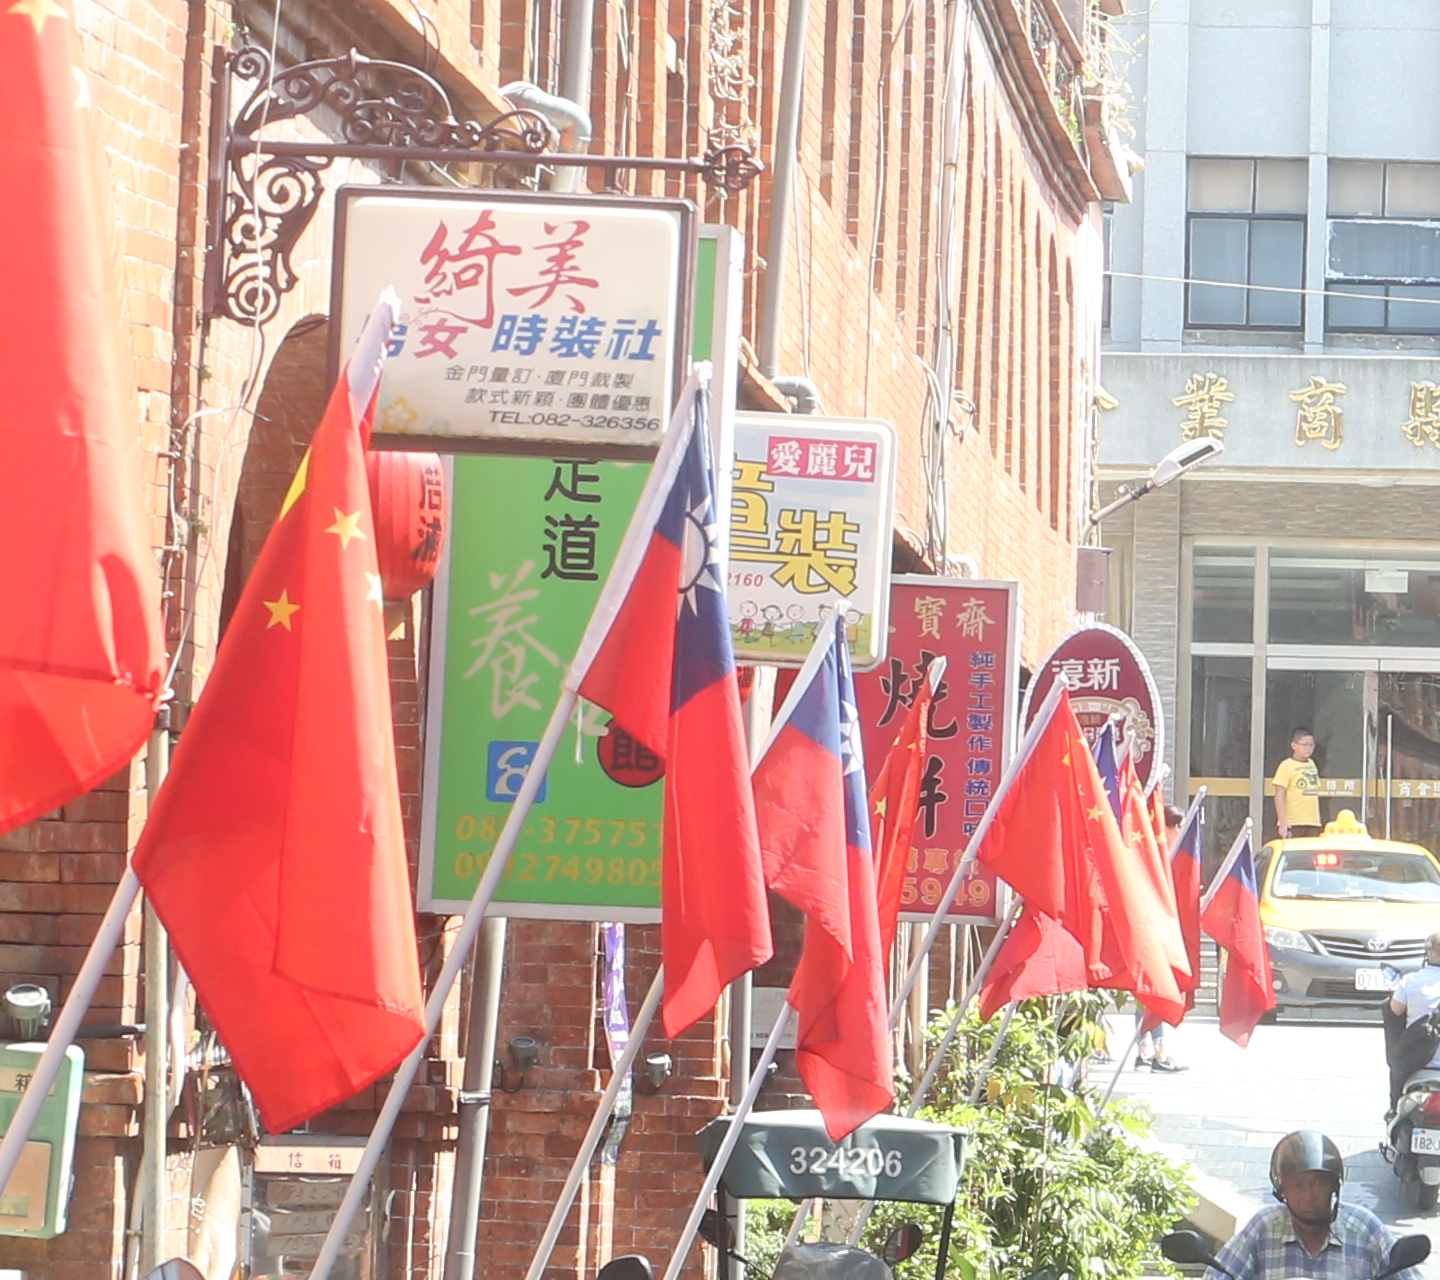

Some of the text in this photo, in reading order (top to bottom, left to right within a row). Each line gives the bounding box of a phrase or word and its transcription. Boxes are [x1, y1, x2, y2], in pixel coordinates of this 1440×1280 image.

[491, 314, 663, 361] 時裝社
[770, 440, 875, 480] 愛麗兒
[790, 1146, 903, 1178] 324206
